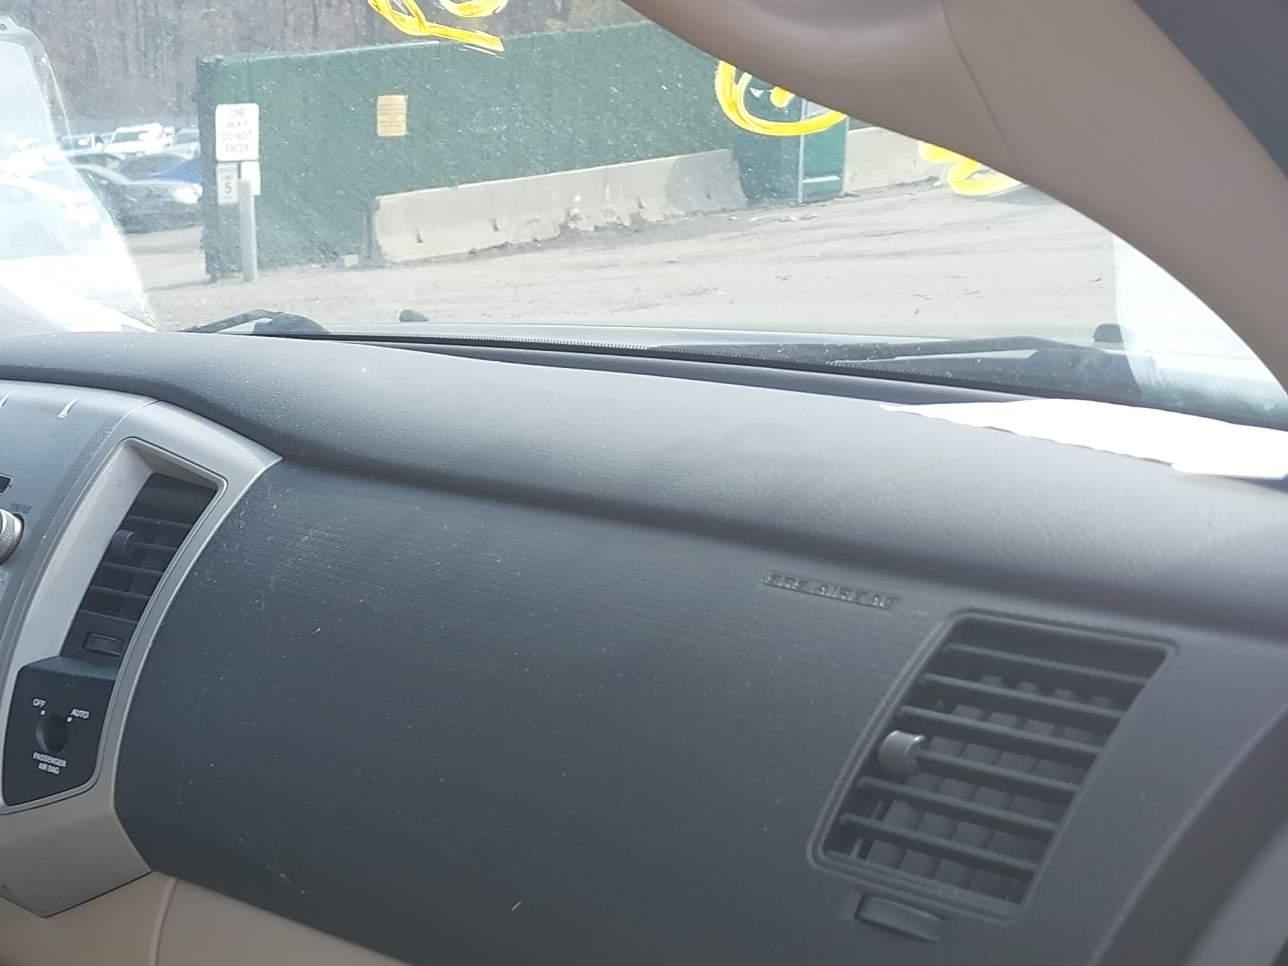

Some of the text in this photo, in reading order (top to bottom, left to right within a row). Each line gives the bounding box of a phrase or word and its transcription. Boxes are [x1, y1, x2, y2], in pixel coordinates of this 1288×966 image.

[224, 143, 249, 153] ENTER
[224, 182, 233, 194] 5
[32, 698, 47, 708] OFF
[70, 708, 90, 720] AUTO
[32, 751, 67, 768] PASSENGER
